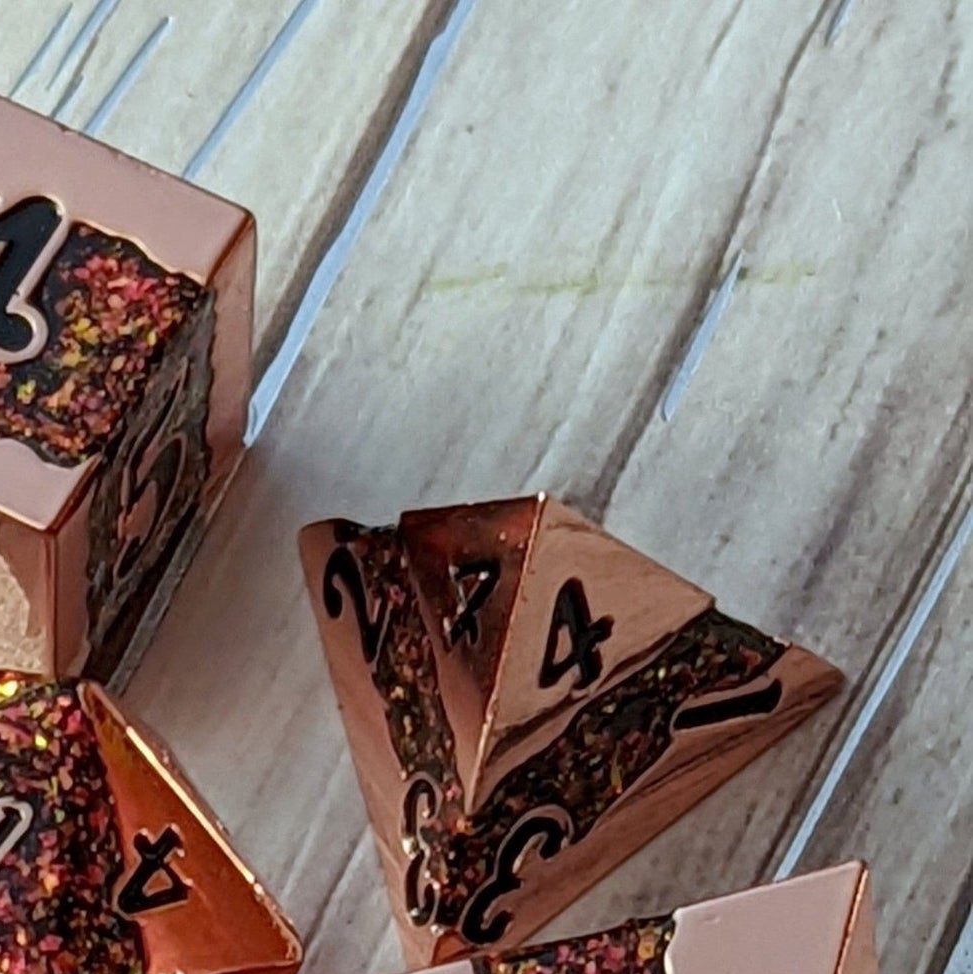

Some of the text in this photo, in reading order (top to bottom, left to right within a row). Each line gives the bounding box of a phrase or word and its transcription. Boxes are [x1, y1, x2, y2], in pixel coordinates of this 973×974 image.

[322, 546, 393, 663] 2
[539, 577, 615, 692] 4
[672, 678, 784, 733] 1
[119, 826, 195, 917] 4
[460, 814, 567, 945] 3
